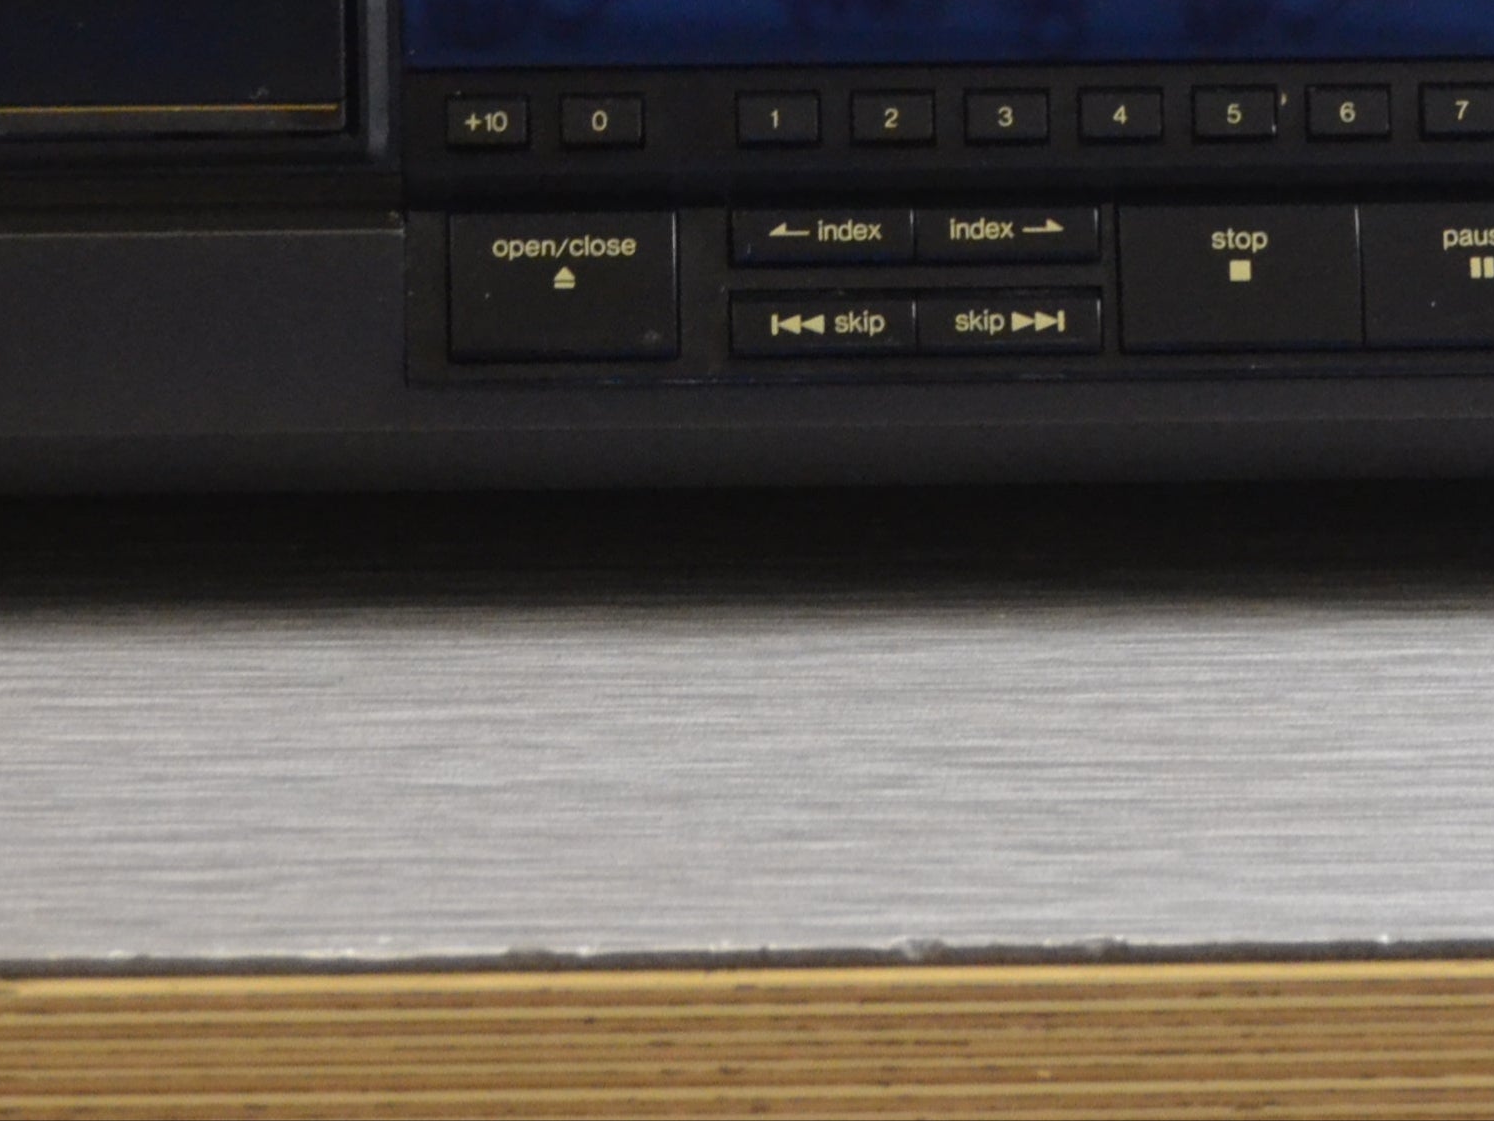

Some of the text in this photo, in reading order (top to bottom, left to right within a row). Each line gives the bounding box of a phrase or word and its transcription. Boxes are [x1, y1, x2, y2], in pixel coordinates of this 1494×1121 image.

[591, 110, 607, 131] 0
[770, 109, 779, 129] 1
[885, 108, 898, 129] 2
[998, 107, 1012, 127] 3
[1112, 105, 1128, 125] 4
[1227, 104, 1242, 124] 5
[1339, 103, 1355, 122] 6
[1455, 101, 1469, 121] 7
[464, 111, 508, 133] +10
[817, 218, 882, 241] index
[949, 217, 1015, 240] index
[492, 233, 637, 259] open/close
[1211, 227, 1268, 252] stop
[835, 309, 885, 335] skip
[955, 308, 1005, 333] skip
